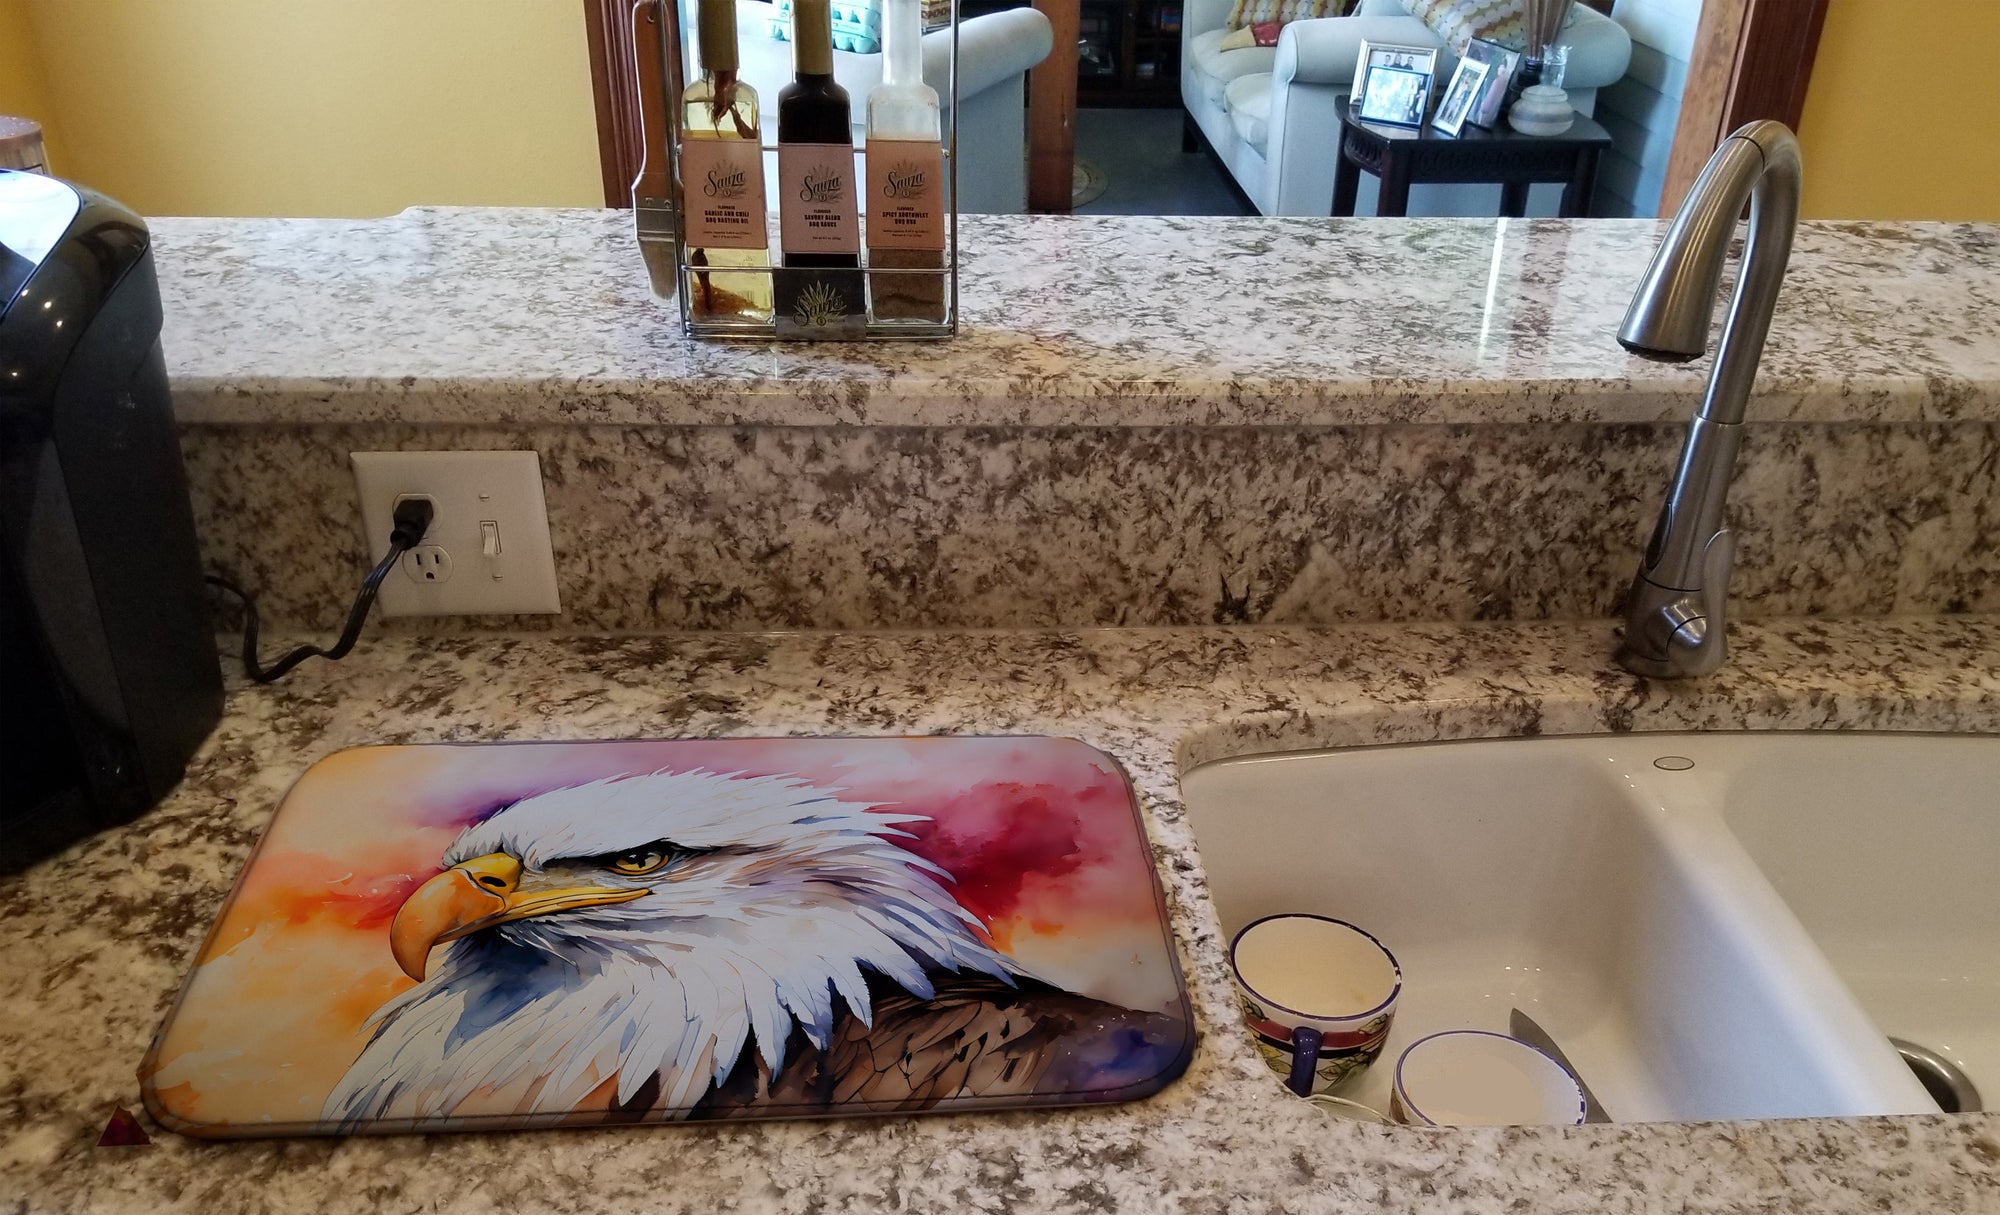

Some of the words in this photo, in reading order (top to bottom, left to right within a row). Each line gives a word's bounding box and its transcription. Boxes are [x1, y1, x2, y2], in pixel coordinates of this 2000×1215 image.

[704, 170, 745, 197] Sauza
[800, 176, 841, 202] Sauza
[883, 171, 925, 198] Sauza
[898, 211, 929, 219] SOUTHWEST
[793, 296, 844, 327] Sauza
